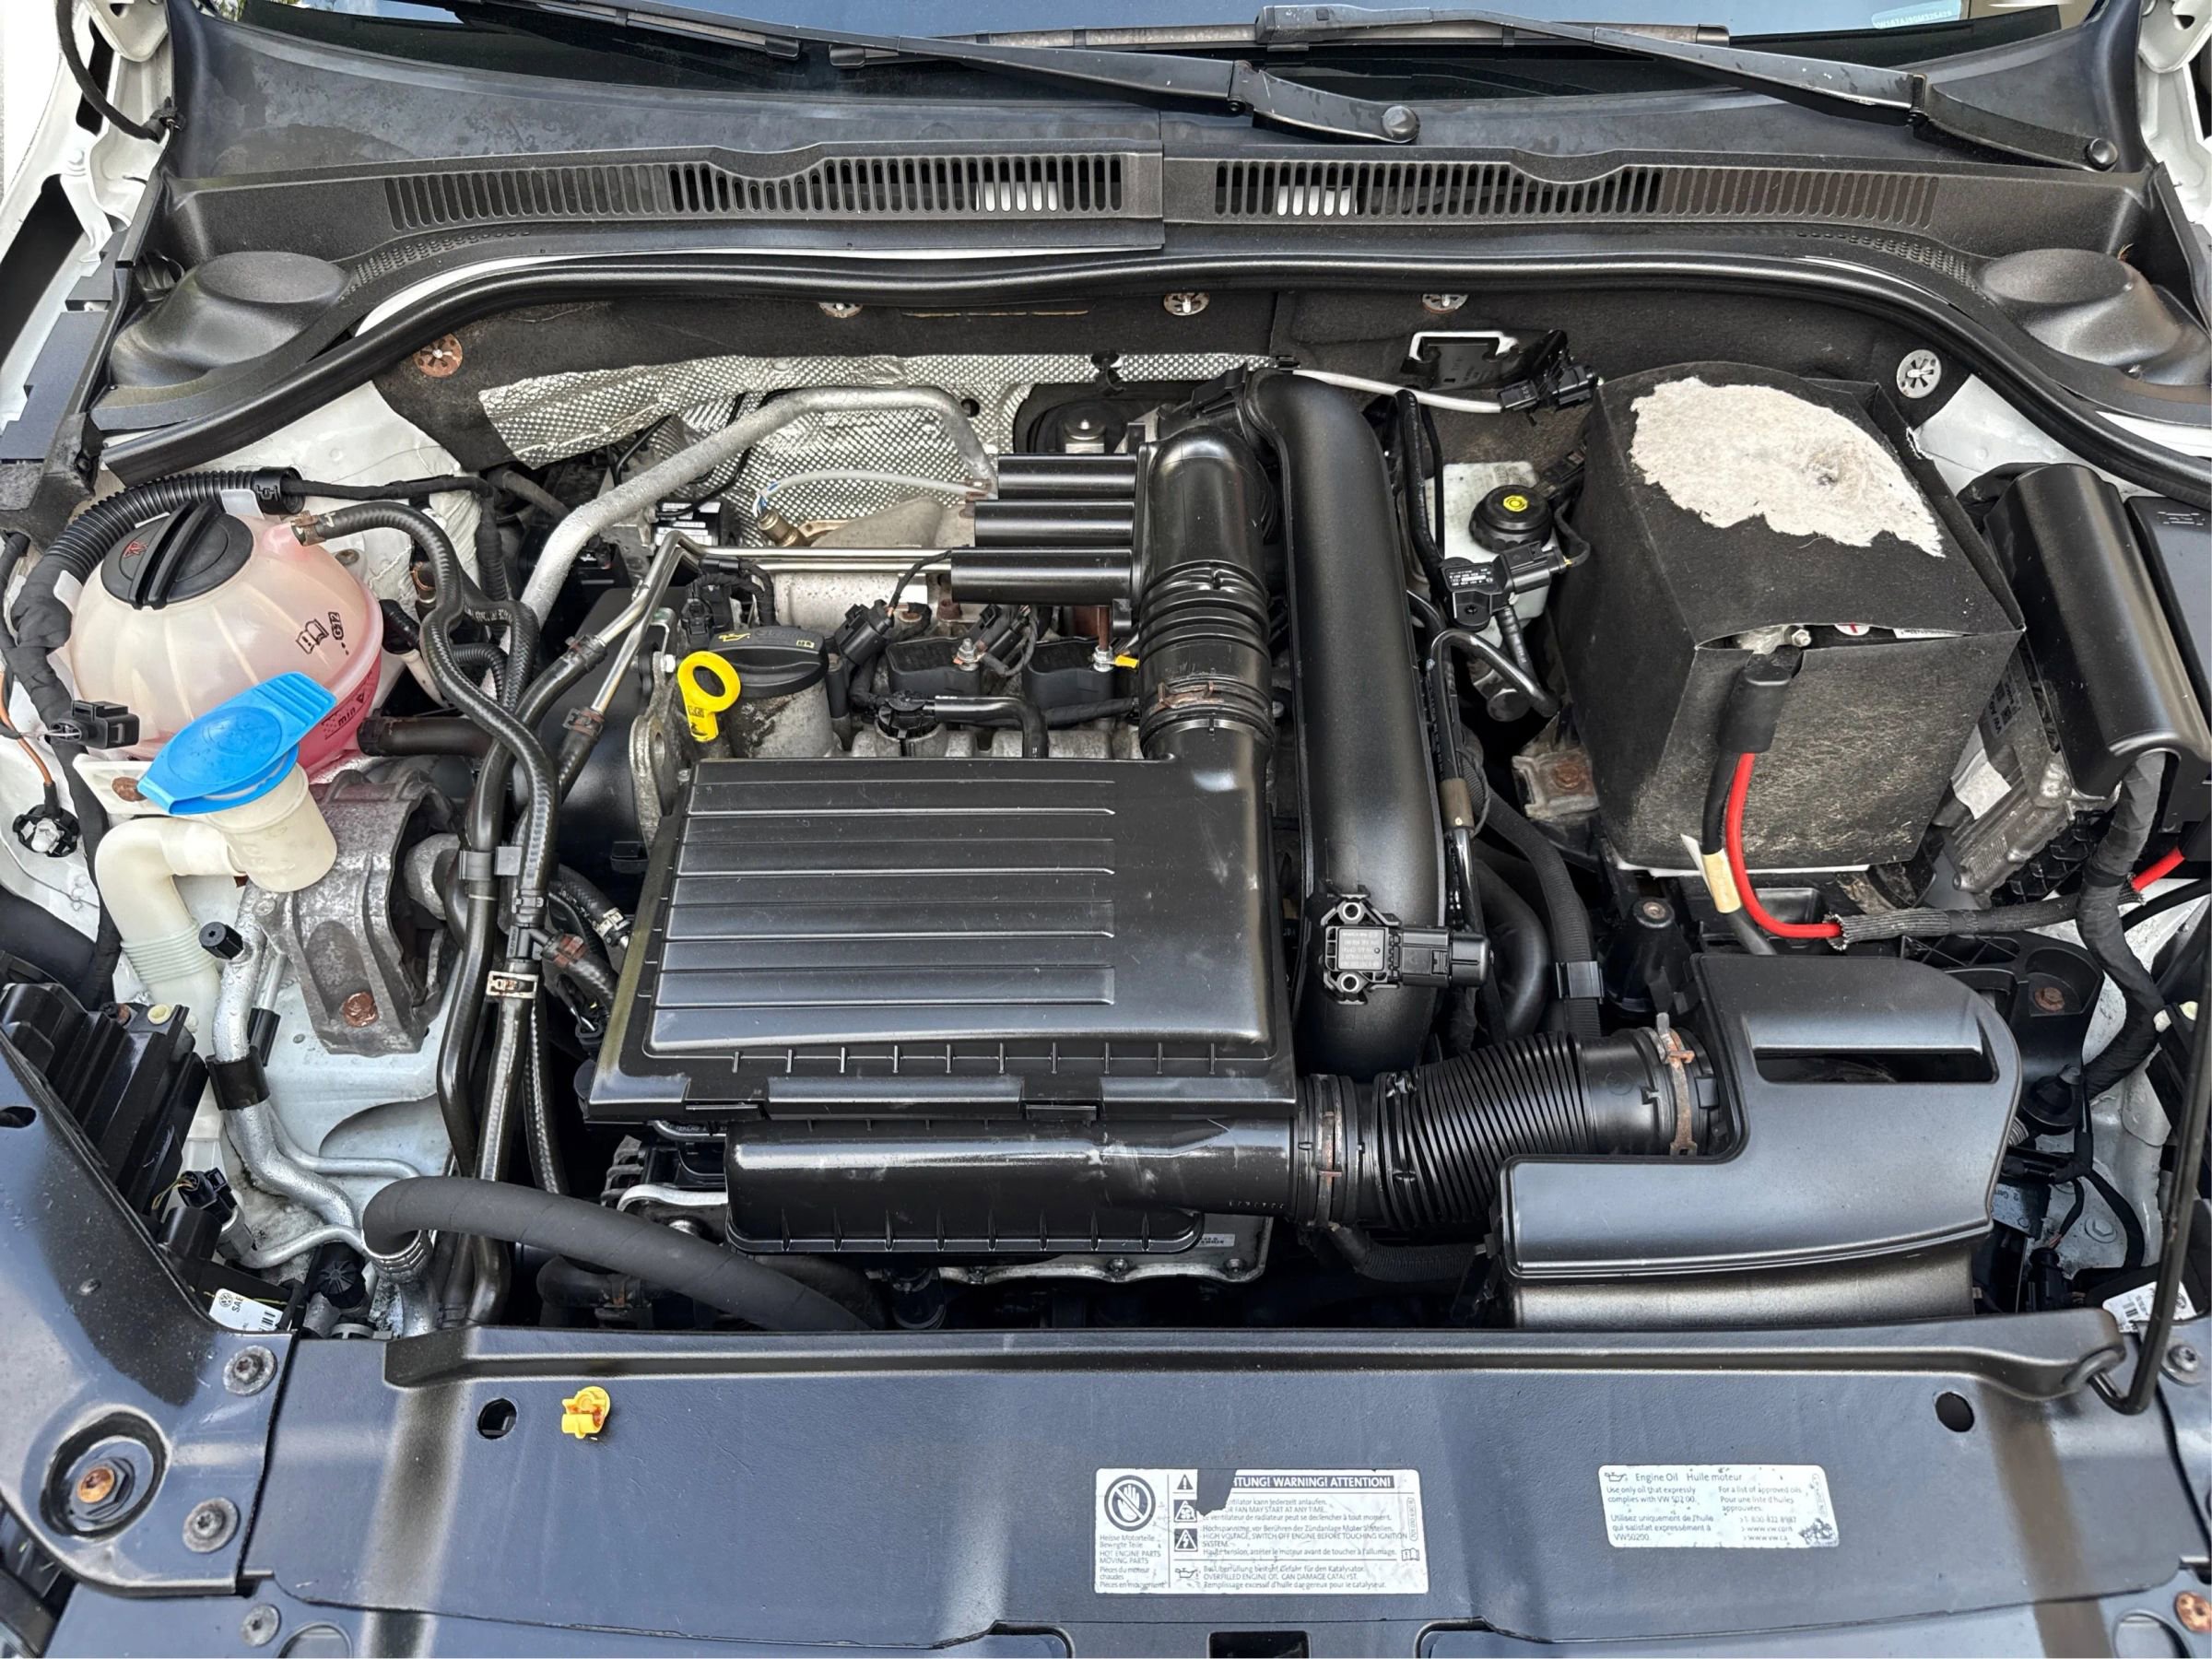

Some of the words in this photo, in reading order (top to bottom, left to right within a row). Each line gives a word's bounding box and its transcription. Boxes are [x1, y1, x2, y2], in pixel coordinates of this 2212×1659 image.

[328, 612, 345, 641] G12
[337, 706, 357, 727] min
[1273, 1476, 1328, 1488] WARNING!
[1330, 1476, 1391, 1488] ATTENTION!
[1635, 1473, 1665, 1484] Engine
[1665, 1473, 1678, 1481] Oil
[1686, 1473, 1710, 1481] Huile
[1620, 1486, 1637, 1495] only
[1663, 1486, 1696, 1496] expressly
[1607, 1496, 1640, 1504] complies
[1285, 1514, 1300, 1523] peut
[1639, 1514, 1680, 1523] uniquement
